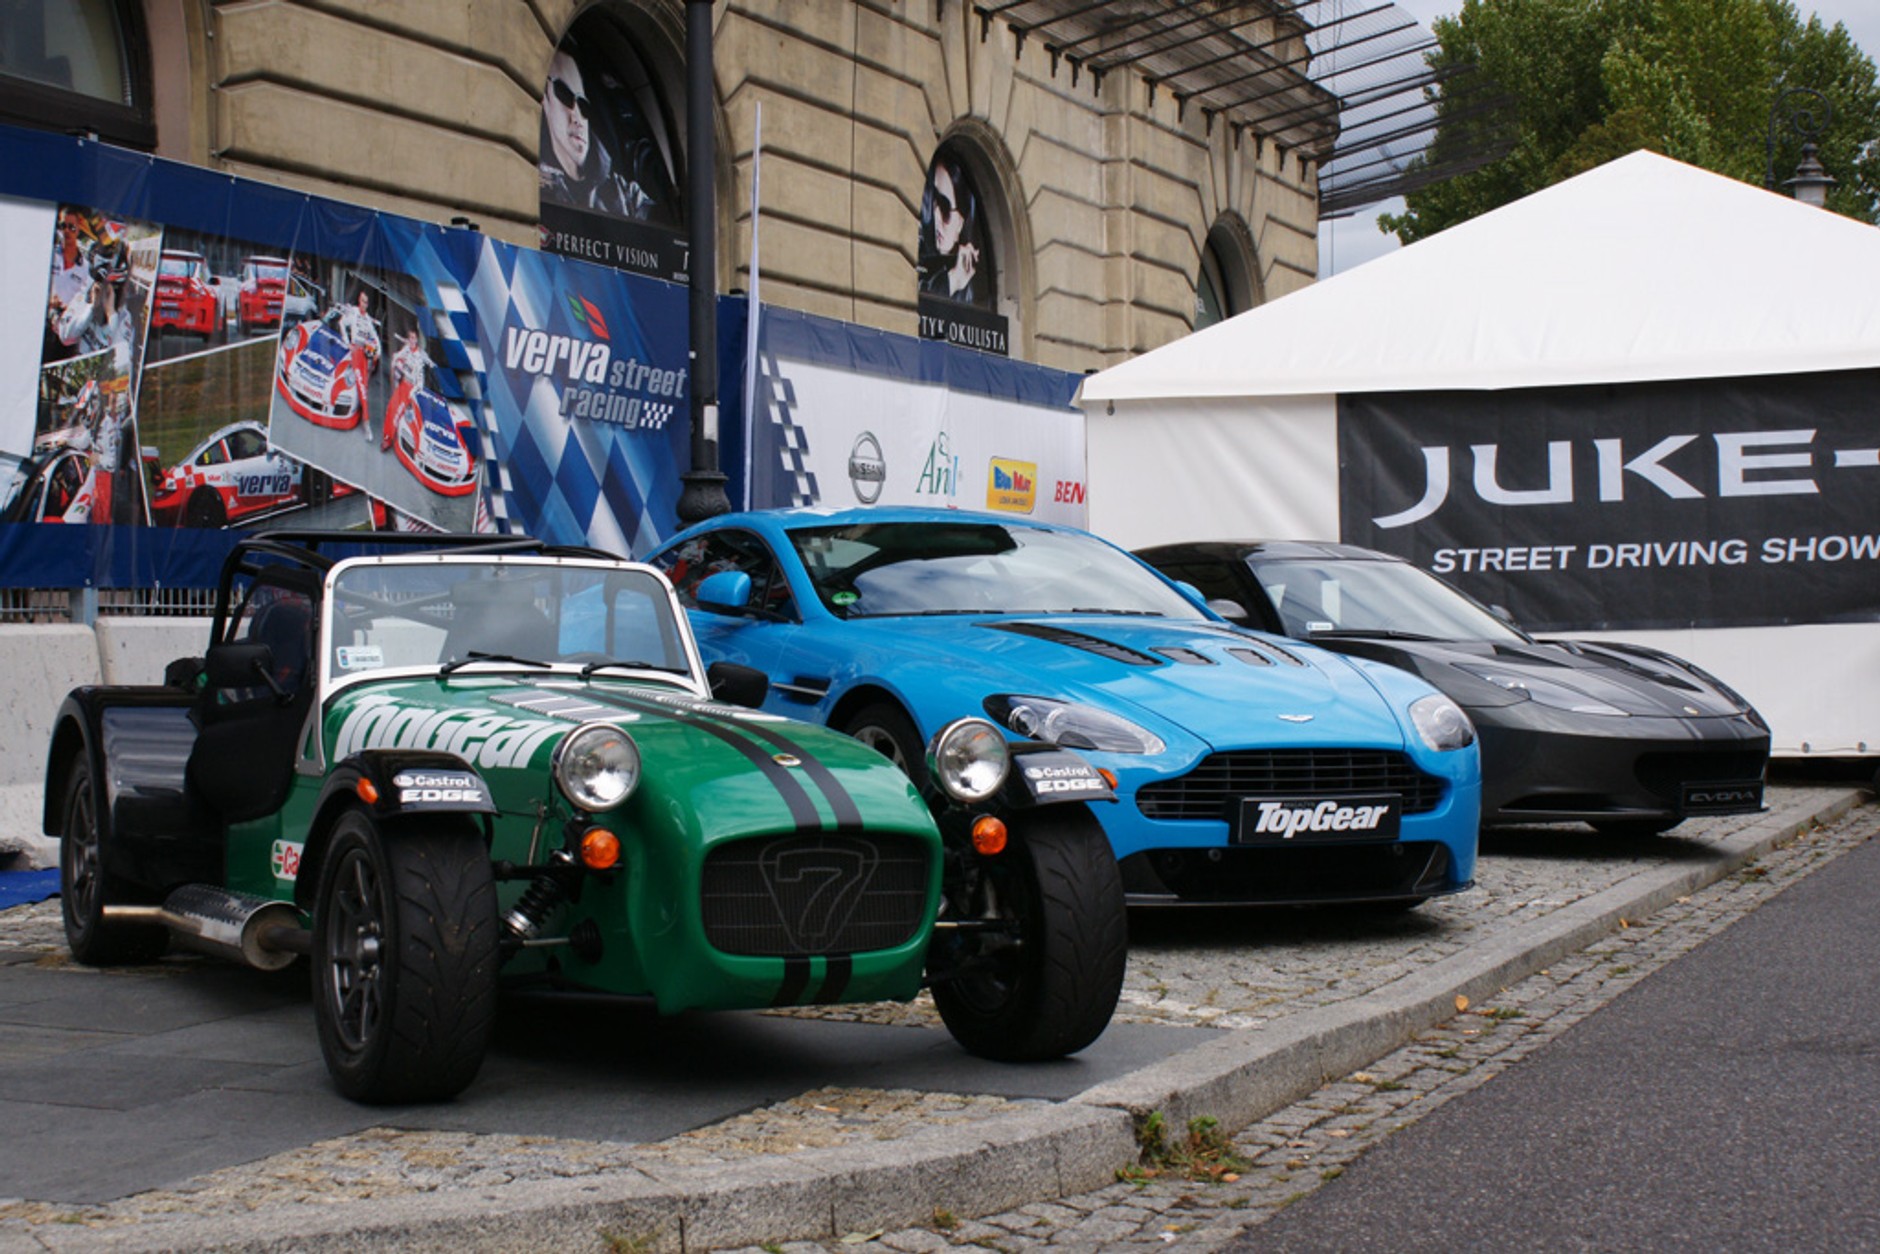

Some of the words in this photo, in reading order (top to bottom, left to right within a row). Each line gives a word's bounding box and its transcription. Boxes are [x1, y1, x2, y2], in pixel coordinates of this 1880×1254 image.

[555, 230, 611, 260] PERFECT
[616, 244, 659, 269] VISION
[949, 320, 1007, 351] OKULISTA
[505, 326, 611, 384] verva
[609, 356, 688, 398] street
[558, 385, 644, 431] racing
[1432, 544, 1577, 573] STREET
[1586, 539, 1748, 570] DRIVING
[1760, 534, 1880, 564] SHOW
[415, 775, 471, 788] Castrol
[1036, 778, 1103, 793] EDGE
[1043, 767, 1090, 777] Castrol
[401, 789, 482, 803] EDGE
[1255, 801, 1389, 839] TopGear
